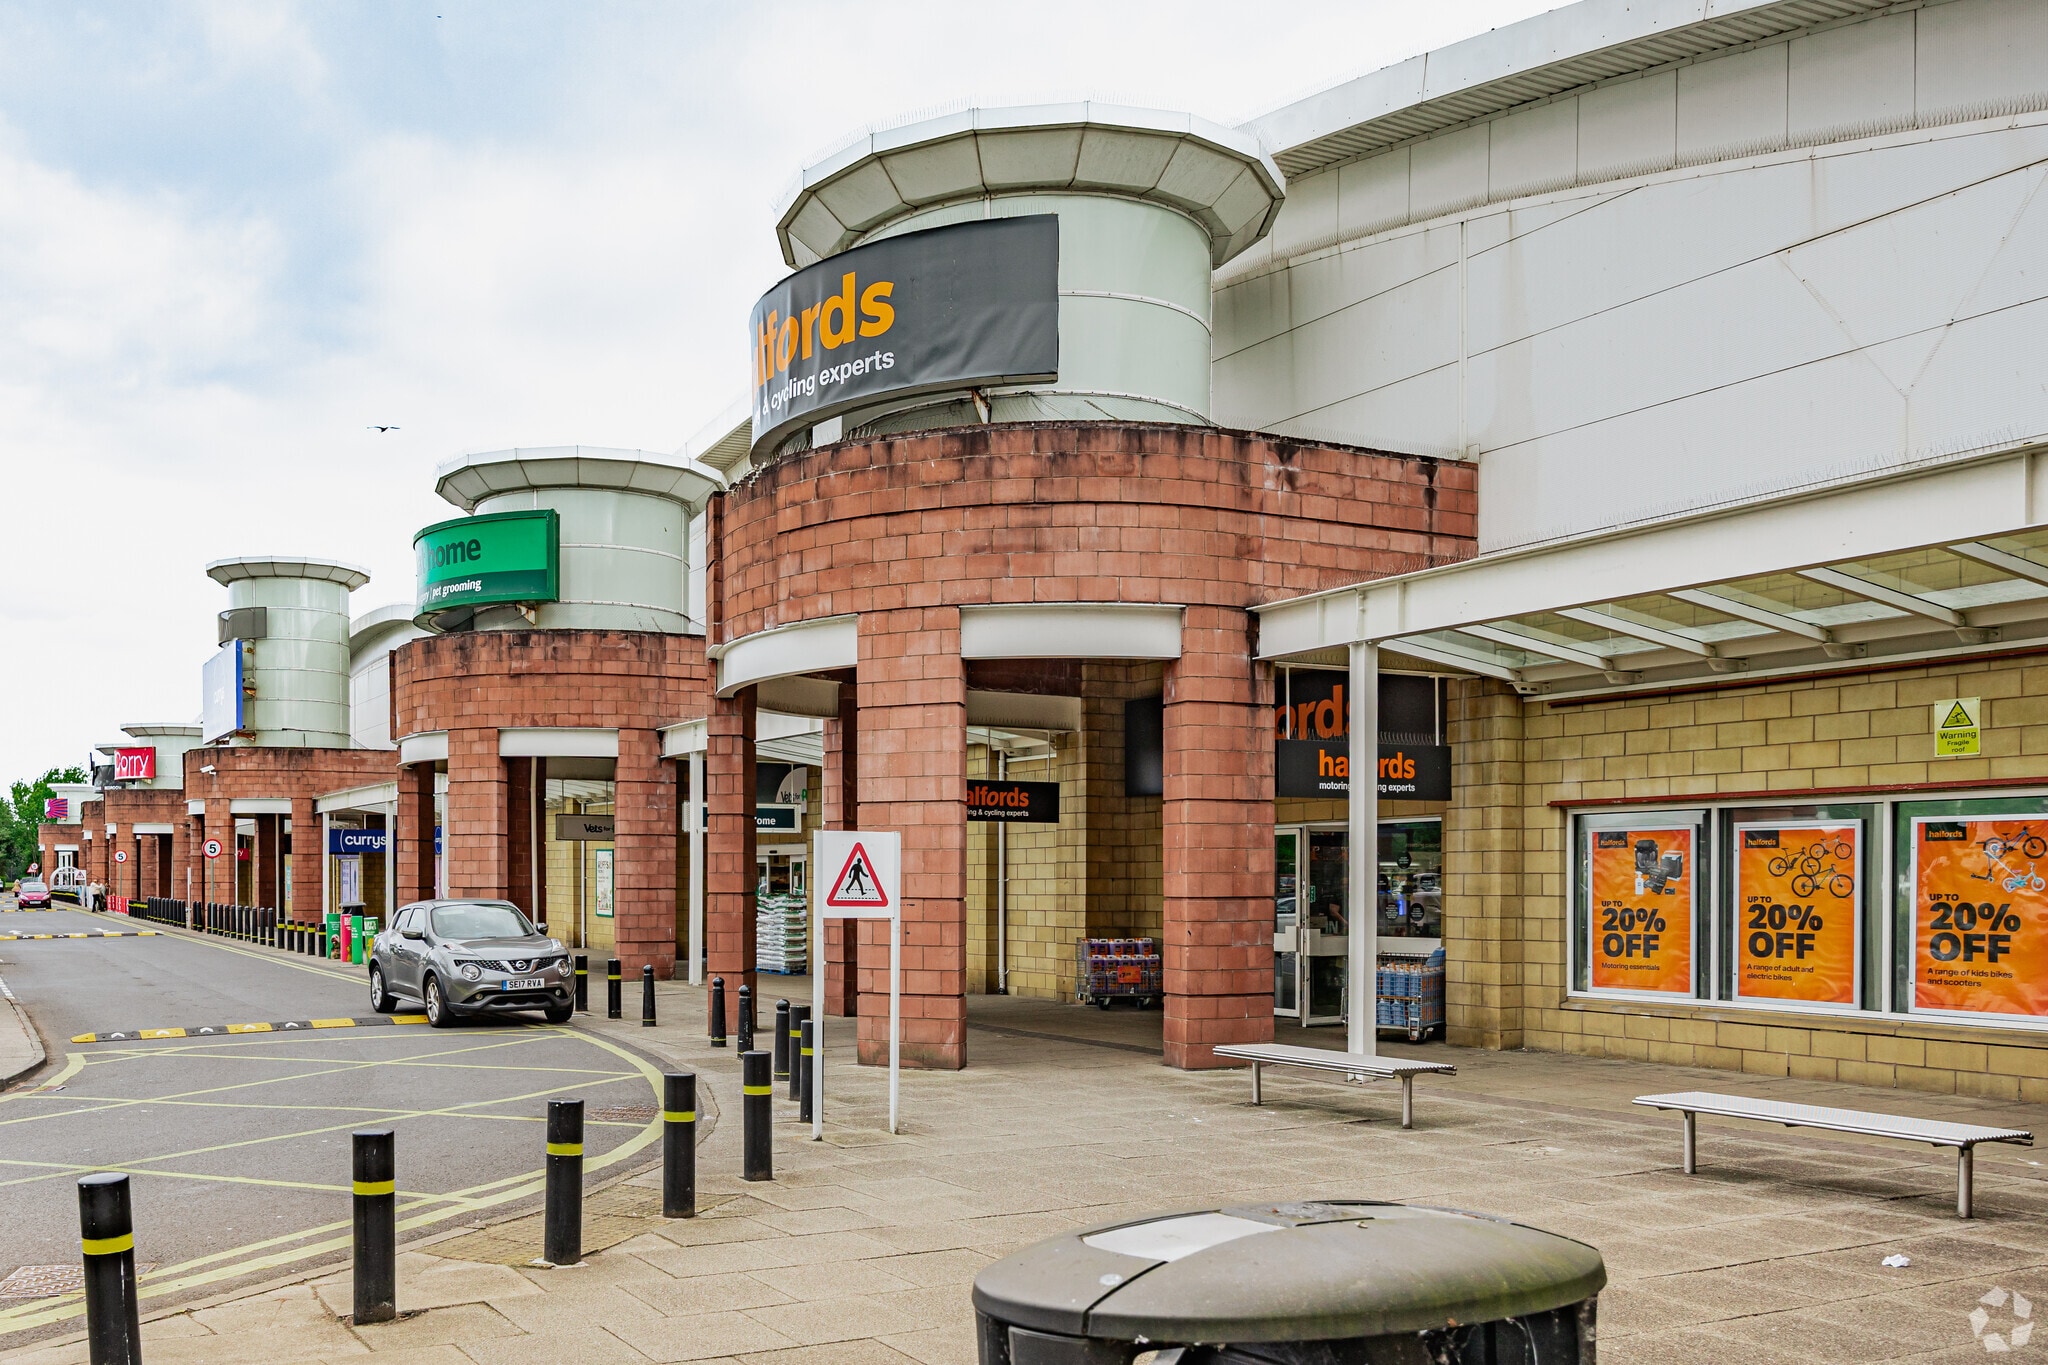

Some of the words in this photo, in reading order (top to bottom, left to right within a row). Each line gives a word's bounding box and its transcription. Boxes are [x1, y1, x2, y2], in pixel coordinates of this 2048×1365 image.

[752, 271, 895, 402] lfords
[771, 374, 815, 410] cycling
[819, 349, 895, 386] experts
[427, 538, 481, 570] home
[442, 579, 482, 598] grooming
[1939, 731, 1977, 740] Warning
[1318, 748, 1416, 780] hards
[1388, 783, 1416, 793] experts
[964, 785, 1030, 808] alfords
[984, 809, 1006, 818] cycling
[756, 817, 775, 825] ome
[584, 823, 603, 833] Vets
[1928, 830, 1963, 839] halfords
[345, 834, 387, 849] currys
[1747, 837, 1777, 847] halfords
[209, 843, 217, 854] 5
[118, 853, 124, 861] 5
[1929, 893, 1943, 901] UP
[1944, 893, 1959, 901] TO
[1601, 900, 1611, 908] UP
[1612, 900, 1623, 908] TO
[1601, 907, 1666, 933] 20%
[1748, 904, 1823, 931] 20%
[1929, 902, 2021, 932] 20%
[1602, 933, 1660, 959] OFF
[1748, 931, 1815, 959] OFF
[1929, 933, 2011, 963] OFF
[1601, 962, 1629, 972] Motoring
[1746, 963, 1753, 971] A
[1753, 965, 1773, 974] range
[1774, 964, 1782, 972] of
[1782, 965, 1801, 973] adult
[1802, 965, 1814, 973] and
[1746, 972, 1772, 981] electric
[1773, 973, 1792, 981] bikes
[1934, 969, 1959, 977] range
[1960, 968, 1970, 976] of
[1971, 969, 1989, 977] kids
[1990, 970, 2013, 978] bikes
[527, 978, 542, 988] RVA
[1927, 978, 1942, 986] and
[1943, 978, 1982, 987] scooters
